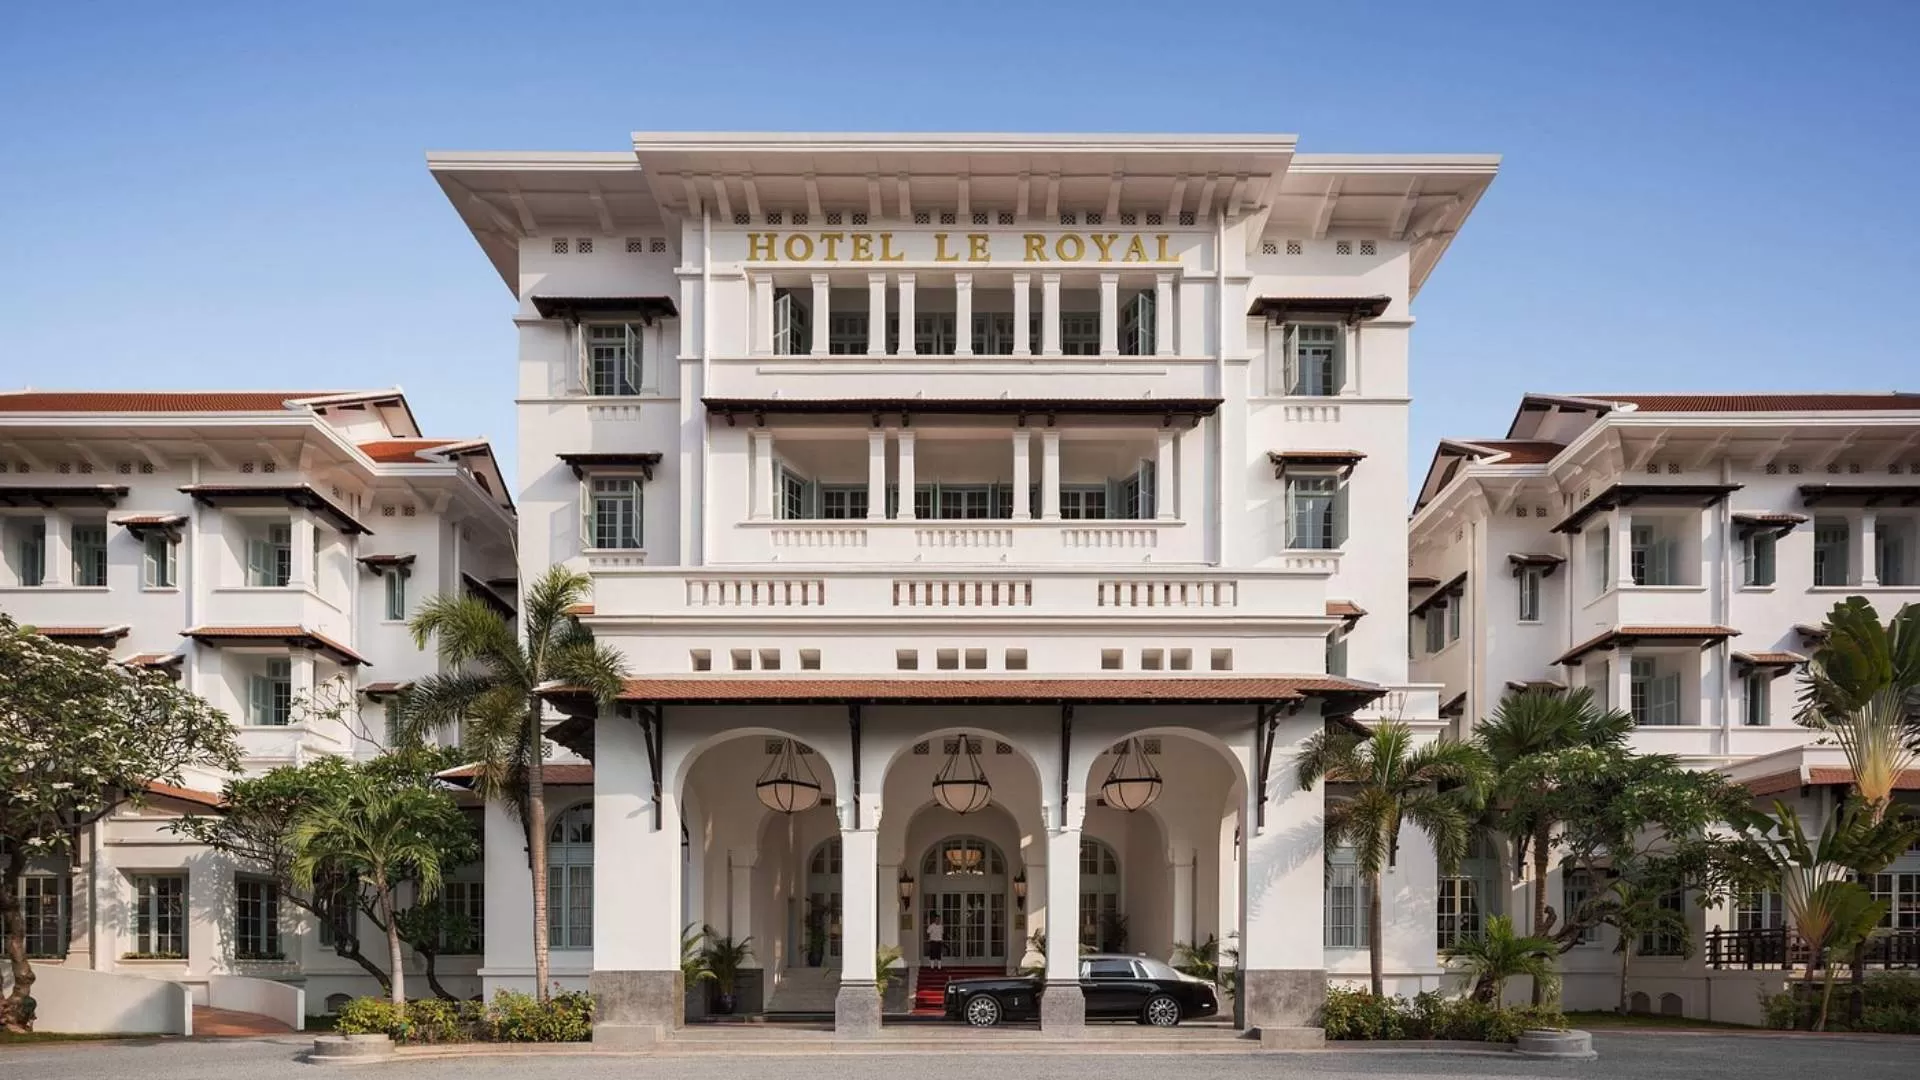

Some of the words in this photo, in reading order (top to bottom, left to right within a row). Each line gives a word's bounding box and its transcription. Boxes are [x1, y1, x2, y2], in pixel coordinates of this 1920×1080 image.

[746, 233, 904, 261] HOTEL
[934, 233, 991, 261] LE
[1023, 233, 1182, 261] ROYAL
